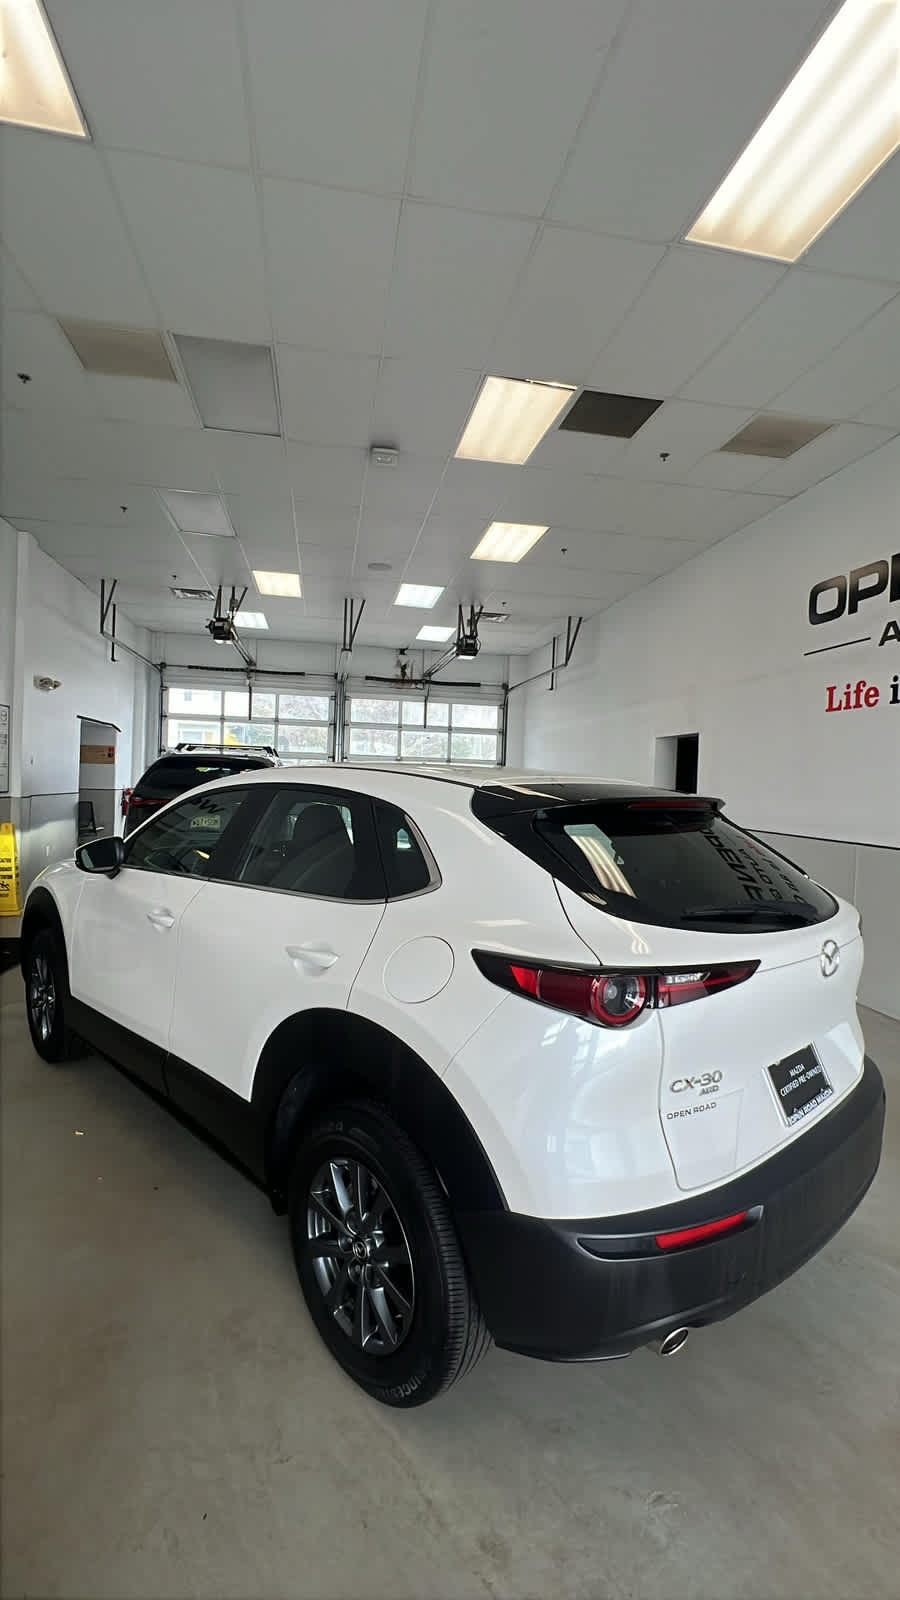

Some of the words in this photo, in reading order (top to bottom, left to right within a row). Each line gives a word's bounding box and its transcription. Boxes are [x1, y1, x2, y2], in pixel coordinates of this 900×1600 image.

[825, 680, 880, 712] Life
[789, 1063, 805, 1077] MAZDA
[670, 1070, 723, 1093] CX-30
[780, 1079, 799, 1097] CERTIFIED
[666, 1108, 692, 1120] OPEN
[693, 1102, 717, 1113] ROAD
[802, 1099, 818, 1115] ROAD
